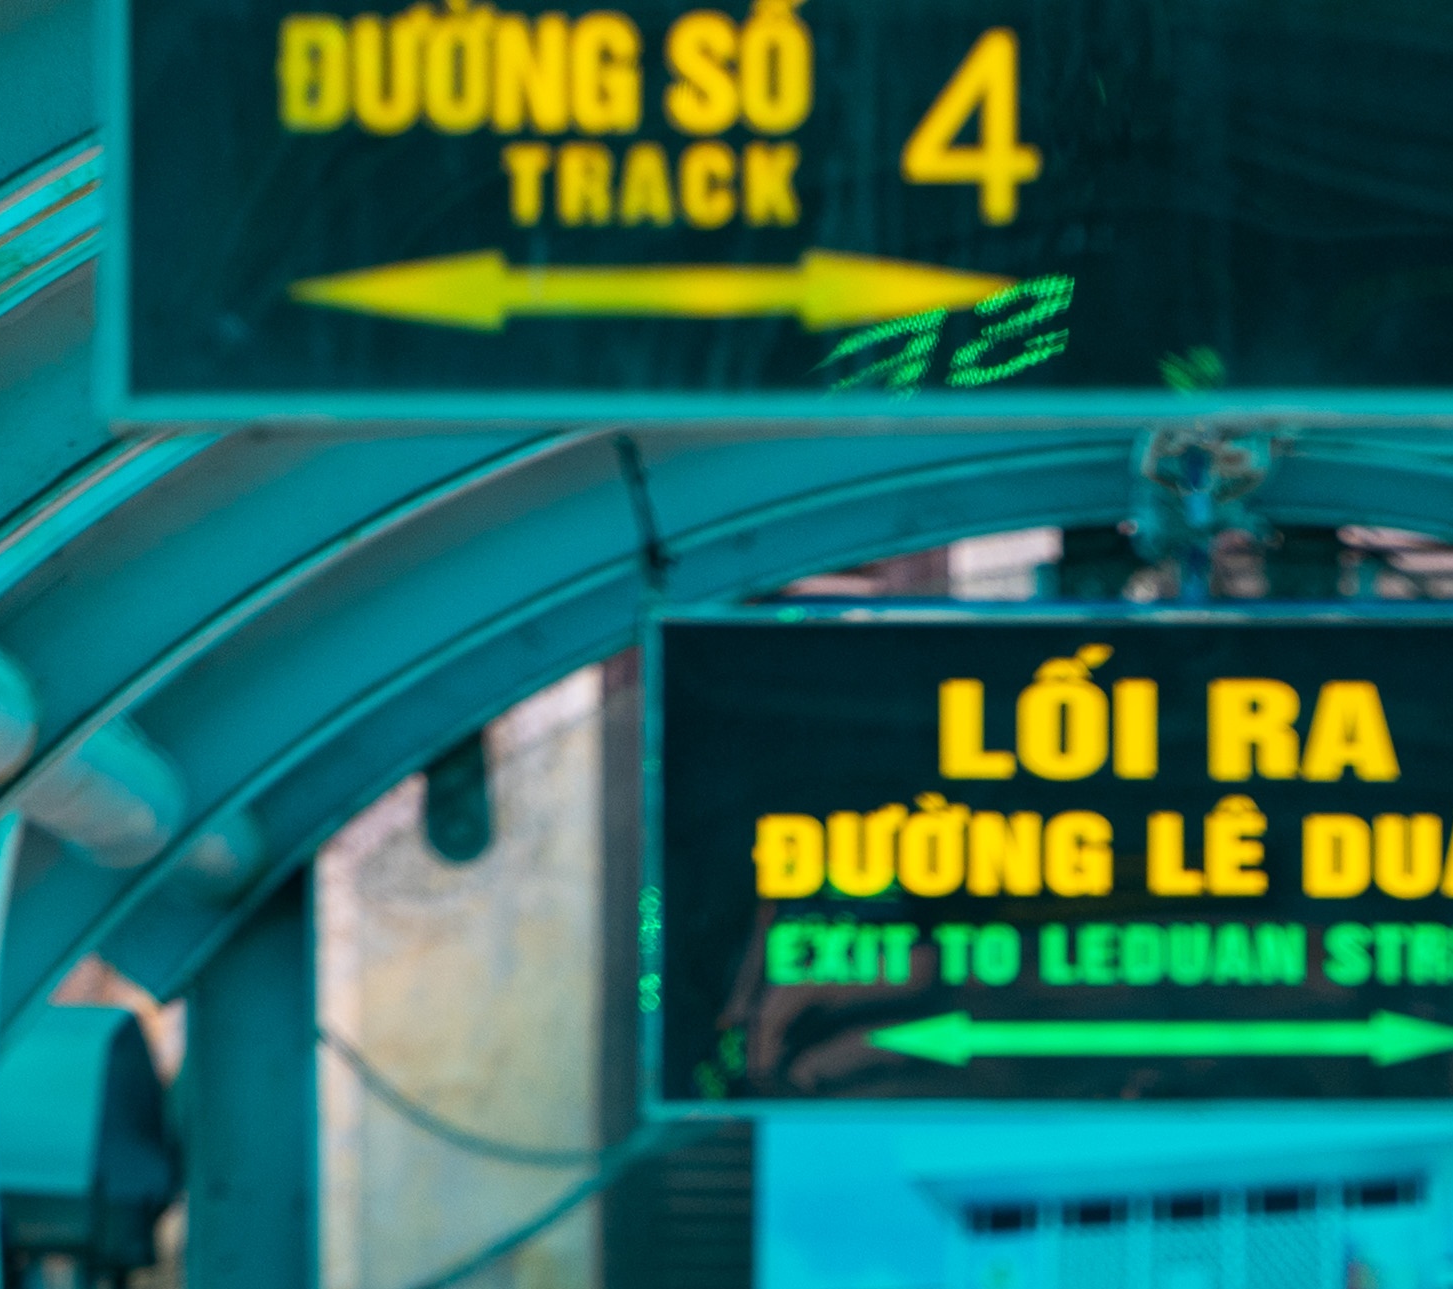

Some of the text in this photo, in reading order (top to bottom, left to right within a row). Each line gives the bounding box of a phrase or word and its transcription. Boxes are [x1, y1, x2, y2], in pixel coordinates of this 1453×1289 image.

[278, 0, 1042, 225] ĐƯỜNG SỐ 4
[502, 140, 801, 228] TRACK
[937, 643, 1402, 783] LỐI RA
[752, 791, 1115, 899] ĐƯỜNG
[1146, 794, 1270, 898] LÊ
[765, 920, 918, 987] EXIT
[932, 920, 1022, 988] TO
[1038, 920, 1307, 988] LEDUAN
